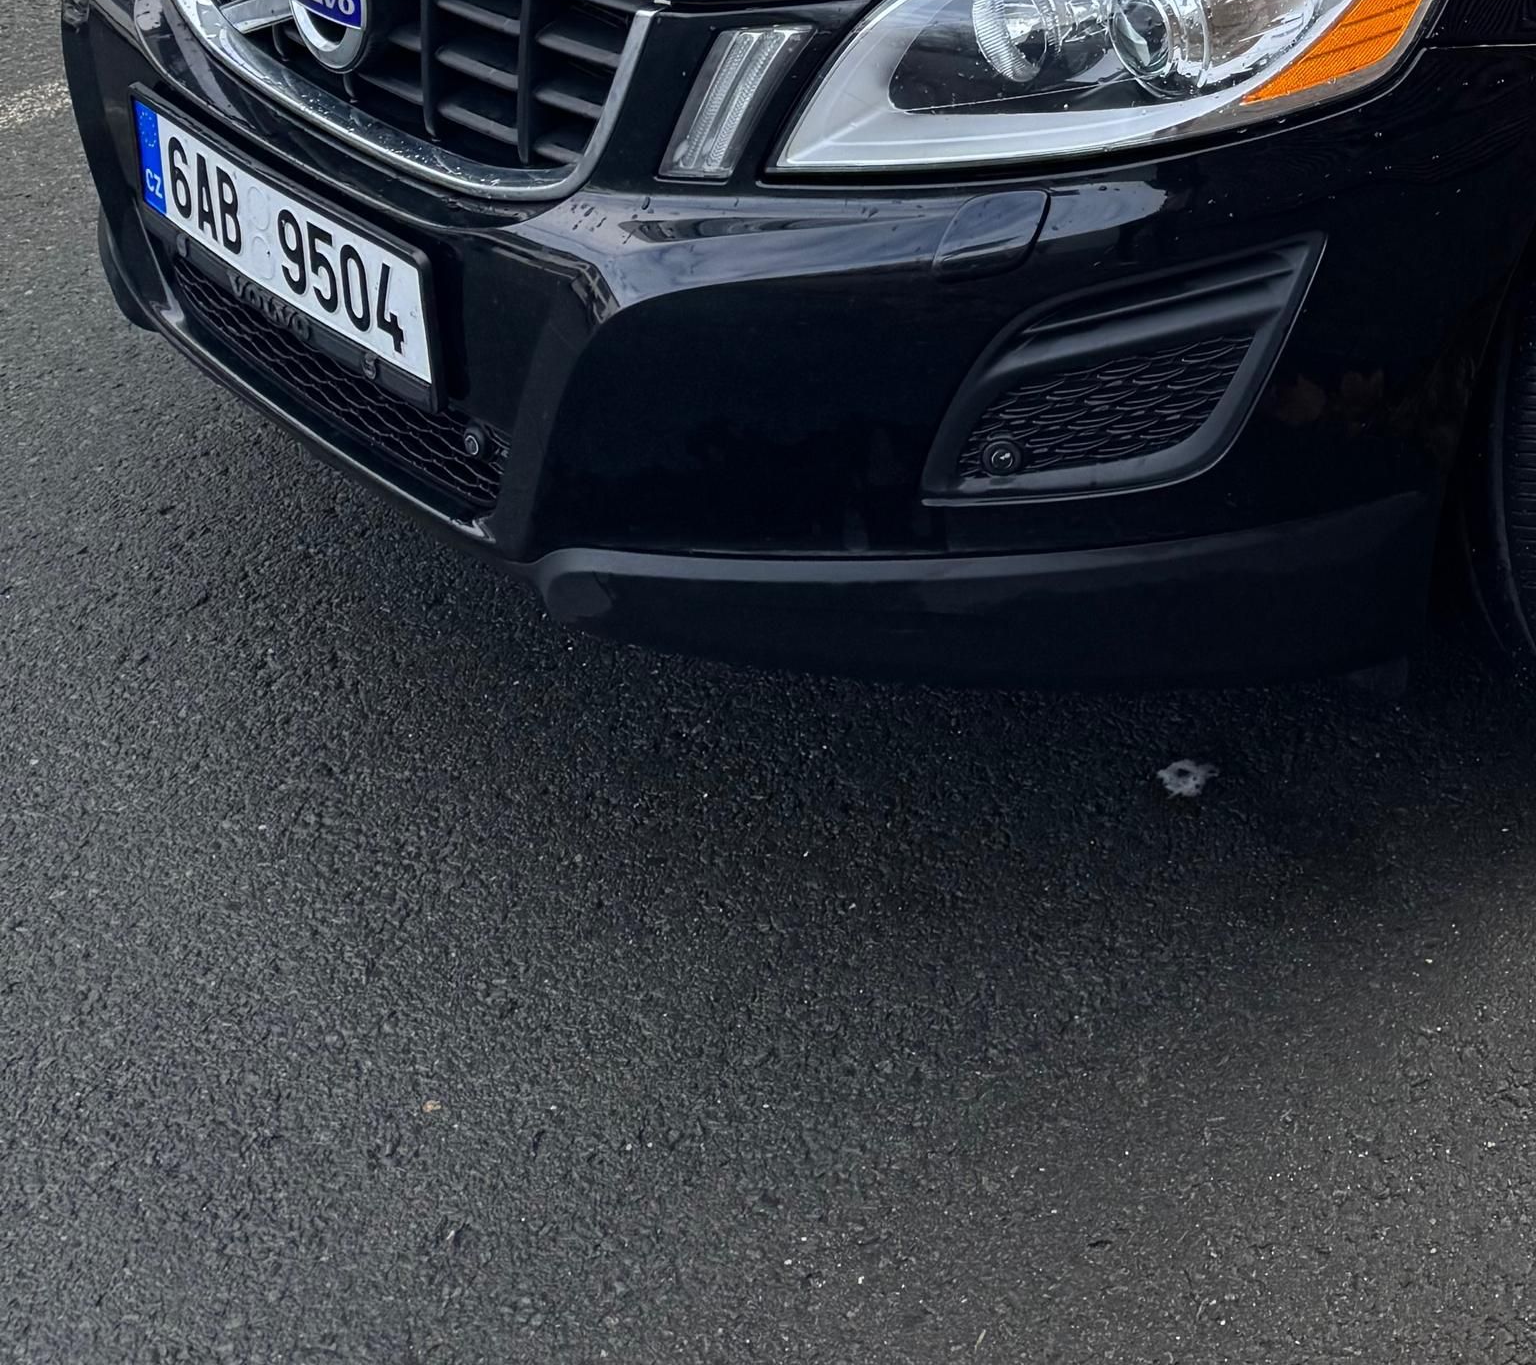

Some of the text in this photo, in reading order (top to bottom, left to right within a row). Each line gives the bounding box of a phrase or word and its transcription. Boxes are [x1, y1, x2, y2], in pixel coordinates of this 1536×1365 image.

[145, 167, 163, 200] CZ
[168, 136, 406, 355] 6AB 9504
